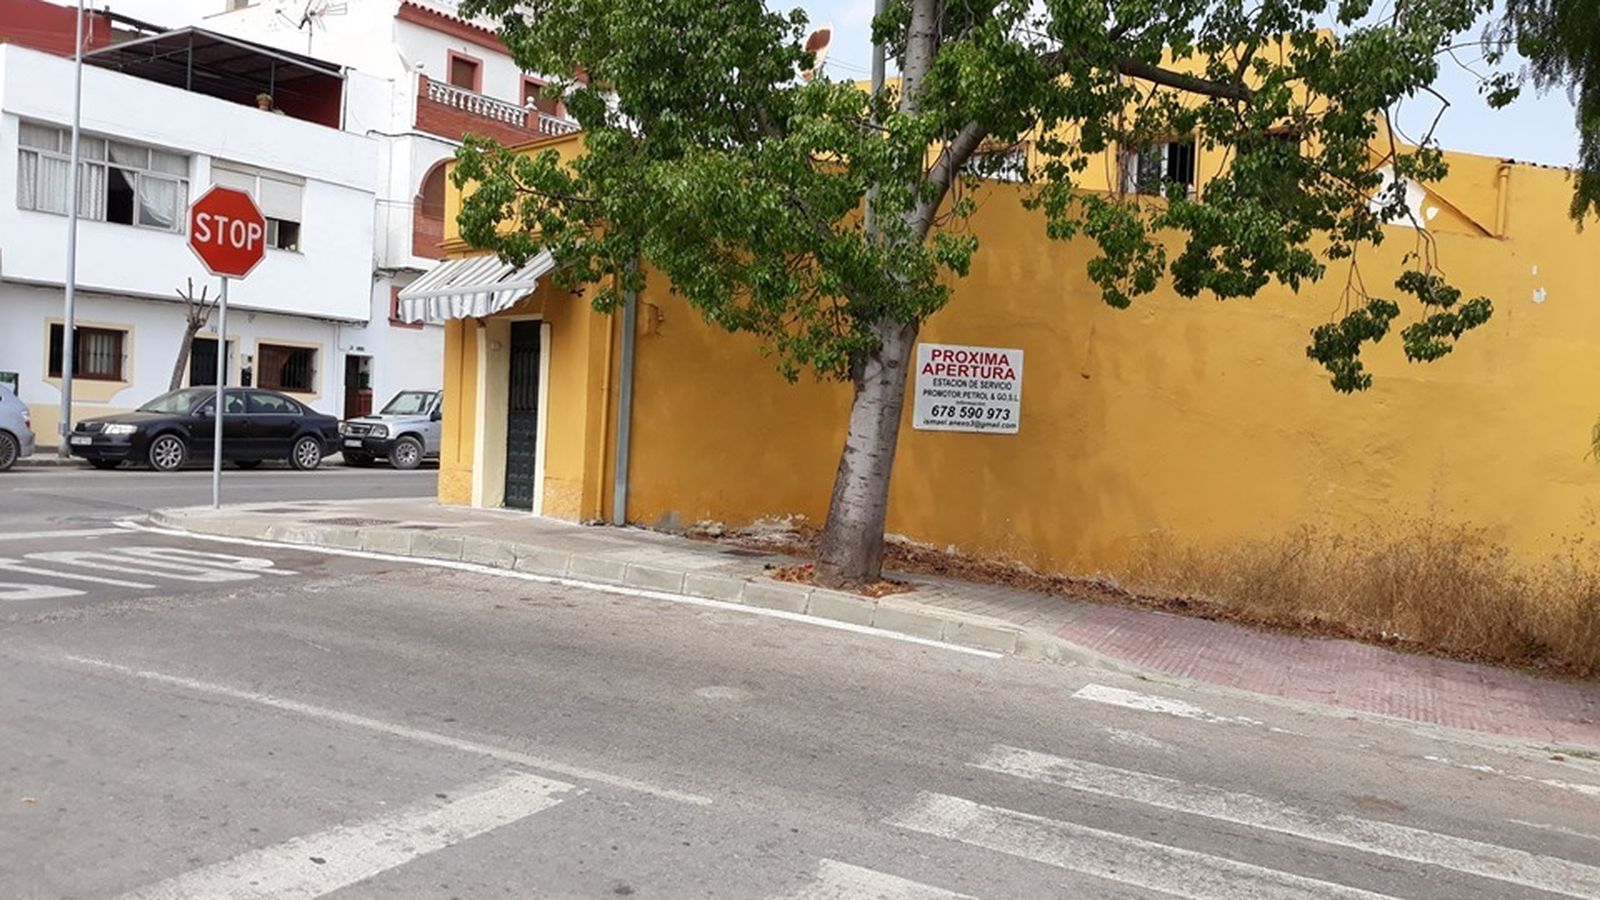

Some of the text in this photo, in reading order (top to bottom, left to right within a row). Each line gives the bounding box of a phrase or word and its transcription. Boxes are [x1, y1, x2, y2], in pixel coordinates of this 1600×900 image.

[195, 212, 262, 251] STOP
[931, 349, 1010, 366] PROXIMA
[922, 362, 1016, 380] APERTURA
[933, 377, 1013, 391] ESTACION DE SERVICIO
[962, 390, 989, 401] PETROL
[990, 392, 996, 401] &
[931, 405, 1011, 421] 678 590 973
